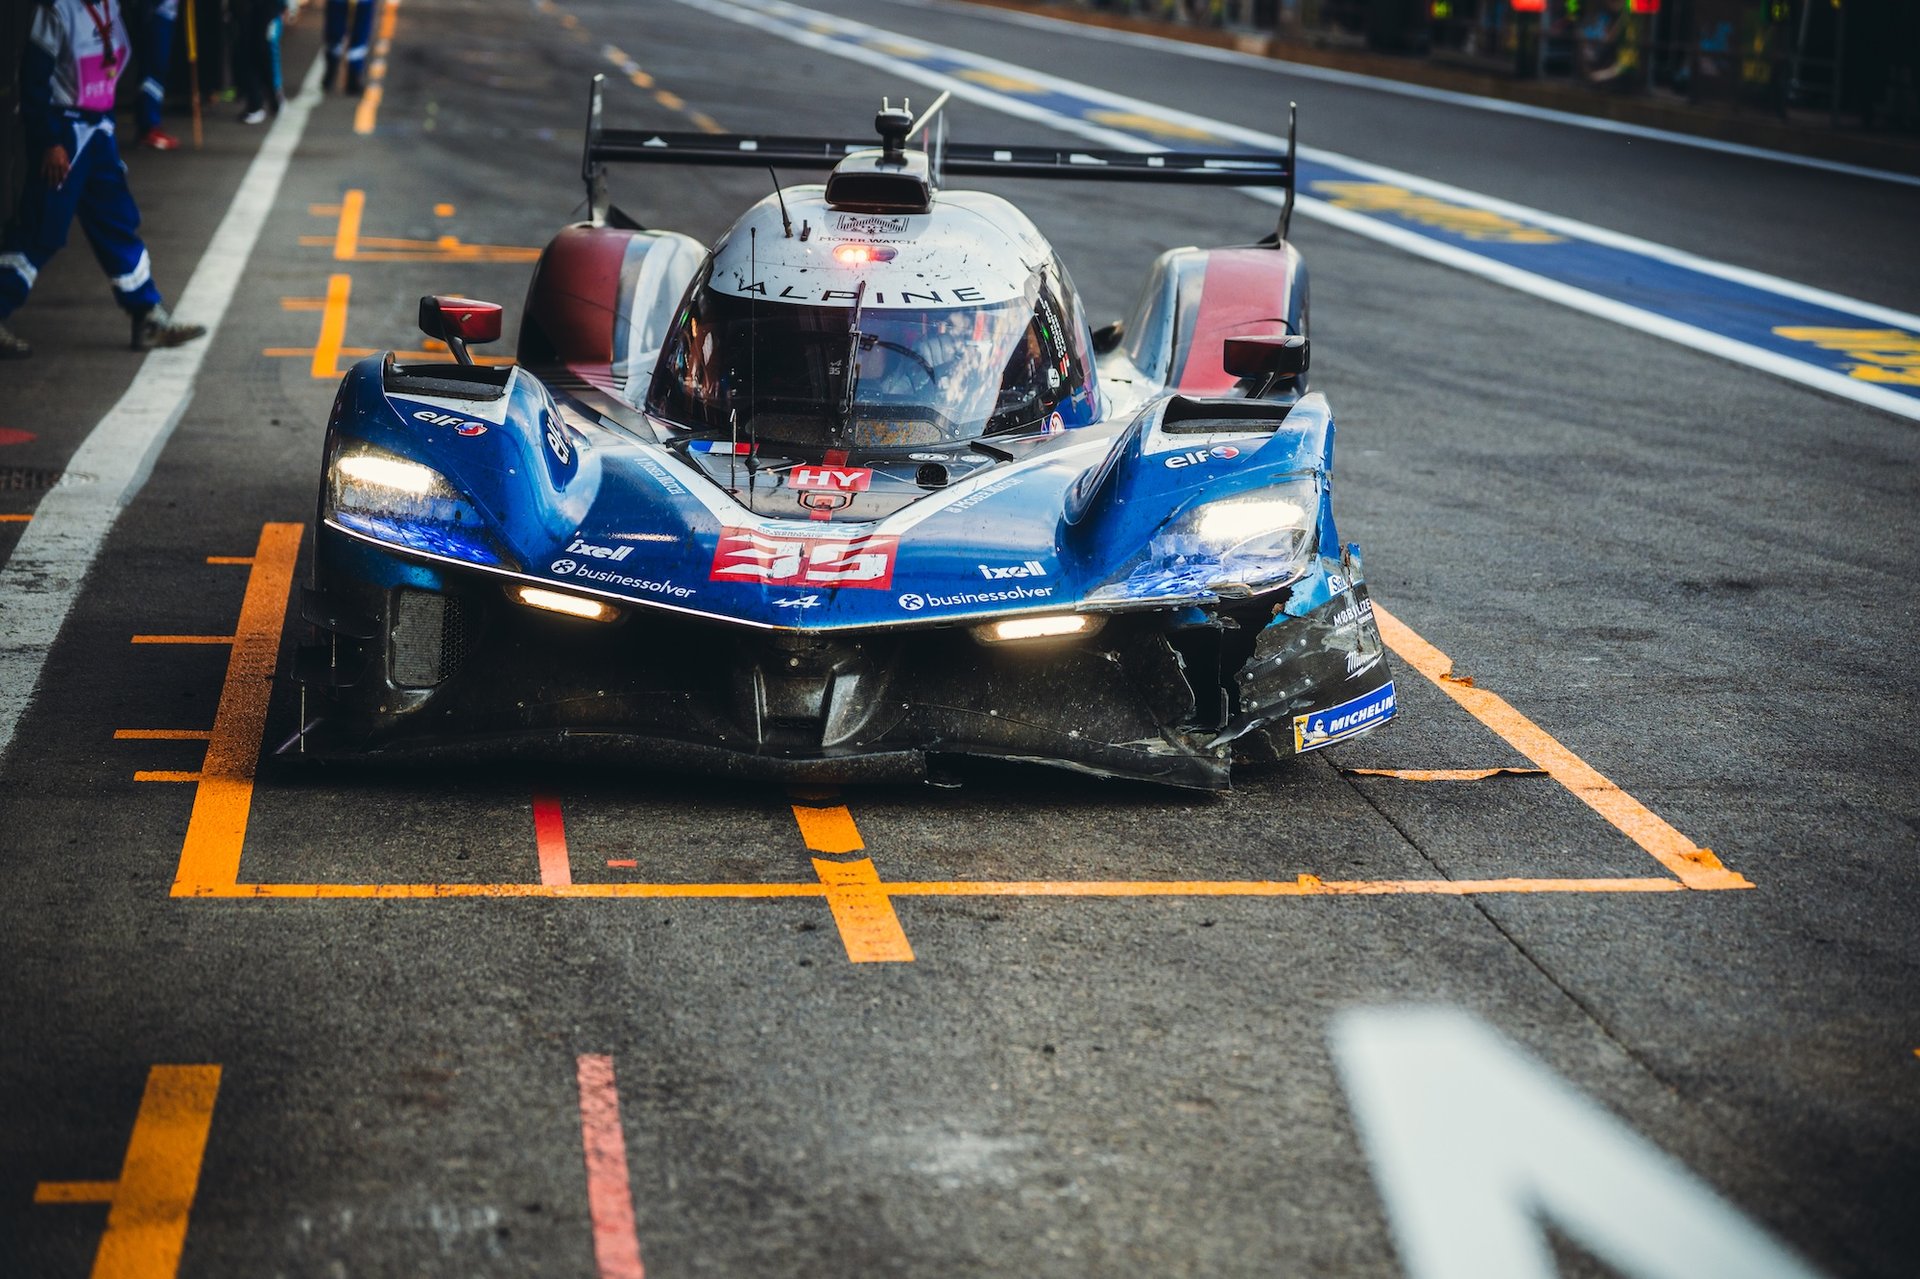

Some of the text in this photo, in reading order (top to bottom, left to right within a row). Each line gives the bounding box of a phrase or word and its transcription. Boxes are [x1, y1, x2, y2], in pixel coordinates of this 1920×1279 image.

[737, 281, 985, 304] ALPINE
[413, 411, 464, 427] elf
[1165, 450, 1209, 469] elf
[796, 469, 865, 487] HY
[565, 539, 635, 561] ixell
[714, 534, 896, 582] 35
[575, 564, 697, 598] businessolver
[978, 560, 1047, 580] ixell
[926, 585, 1053, 607] businessolver
[1329, 695, 1394, 733] MICHELIN
